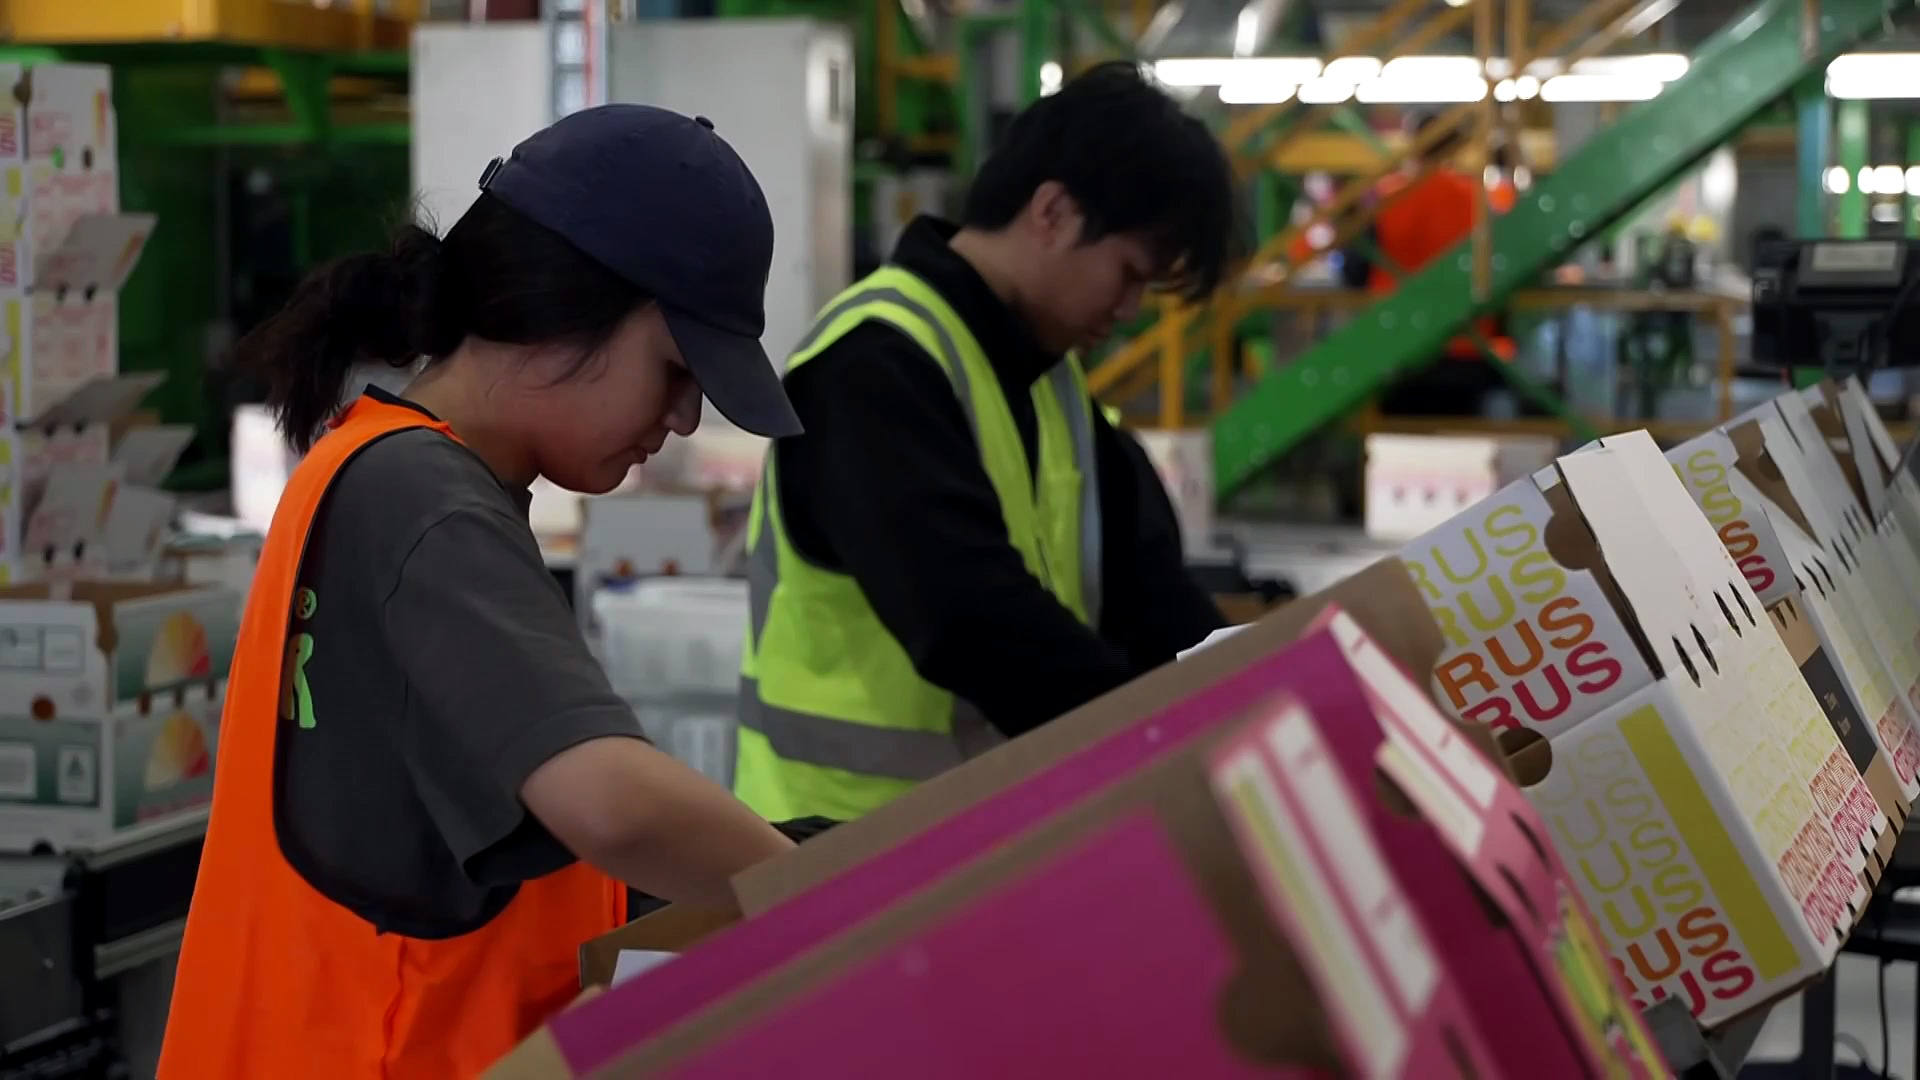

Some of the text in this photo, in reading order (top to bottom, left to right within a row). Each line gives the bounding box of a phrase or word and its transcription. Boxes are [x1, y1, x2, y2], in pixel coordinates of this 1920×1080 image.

[1434, 596, 1594, 710] RUS
[1461, 641, 1622, 729] RUS
[1592, 864, 1704, 948] US
